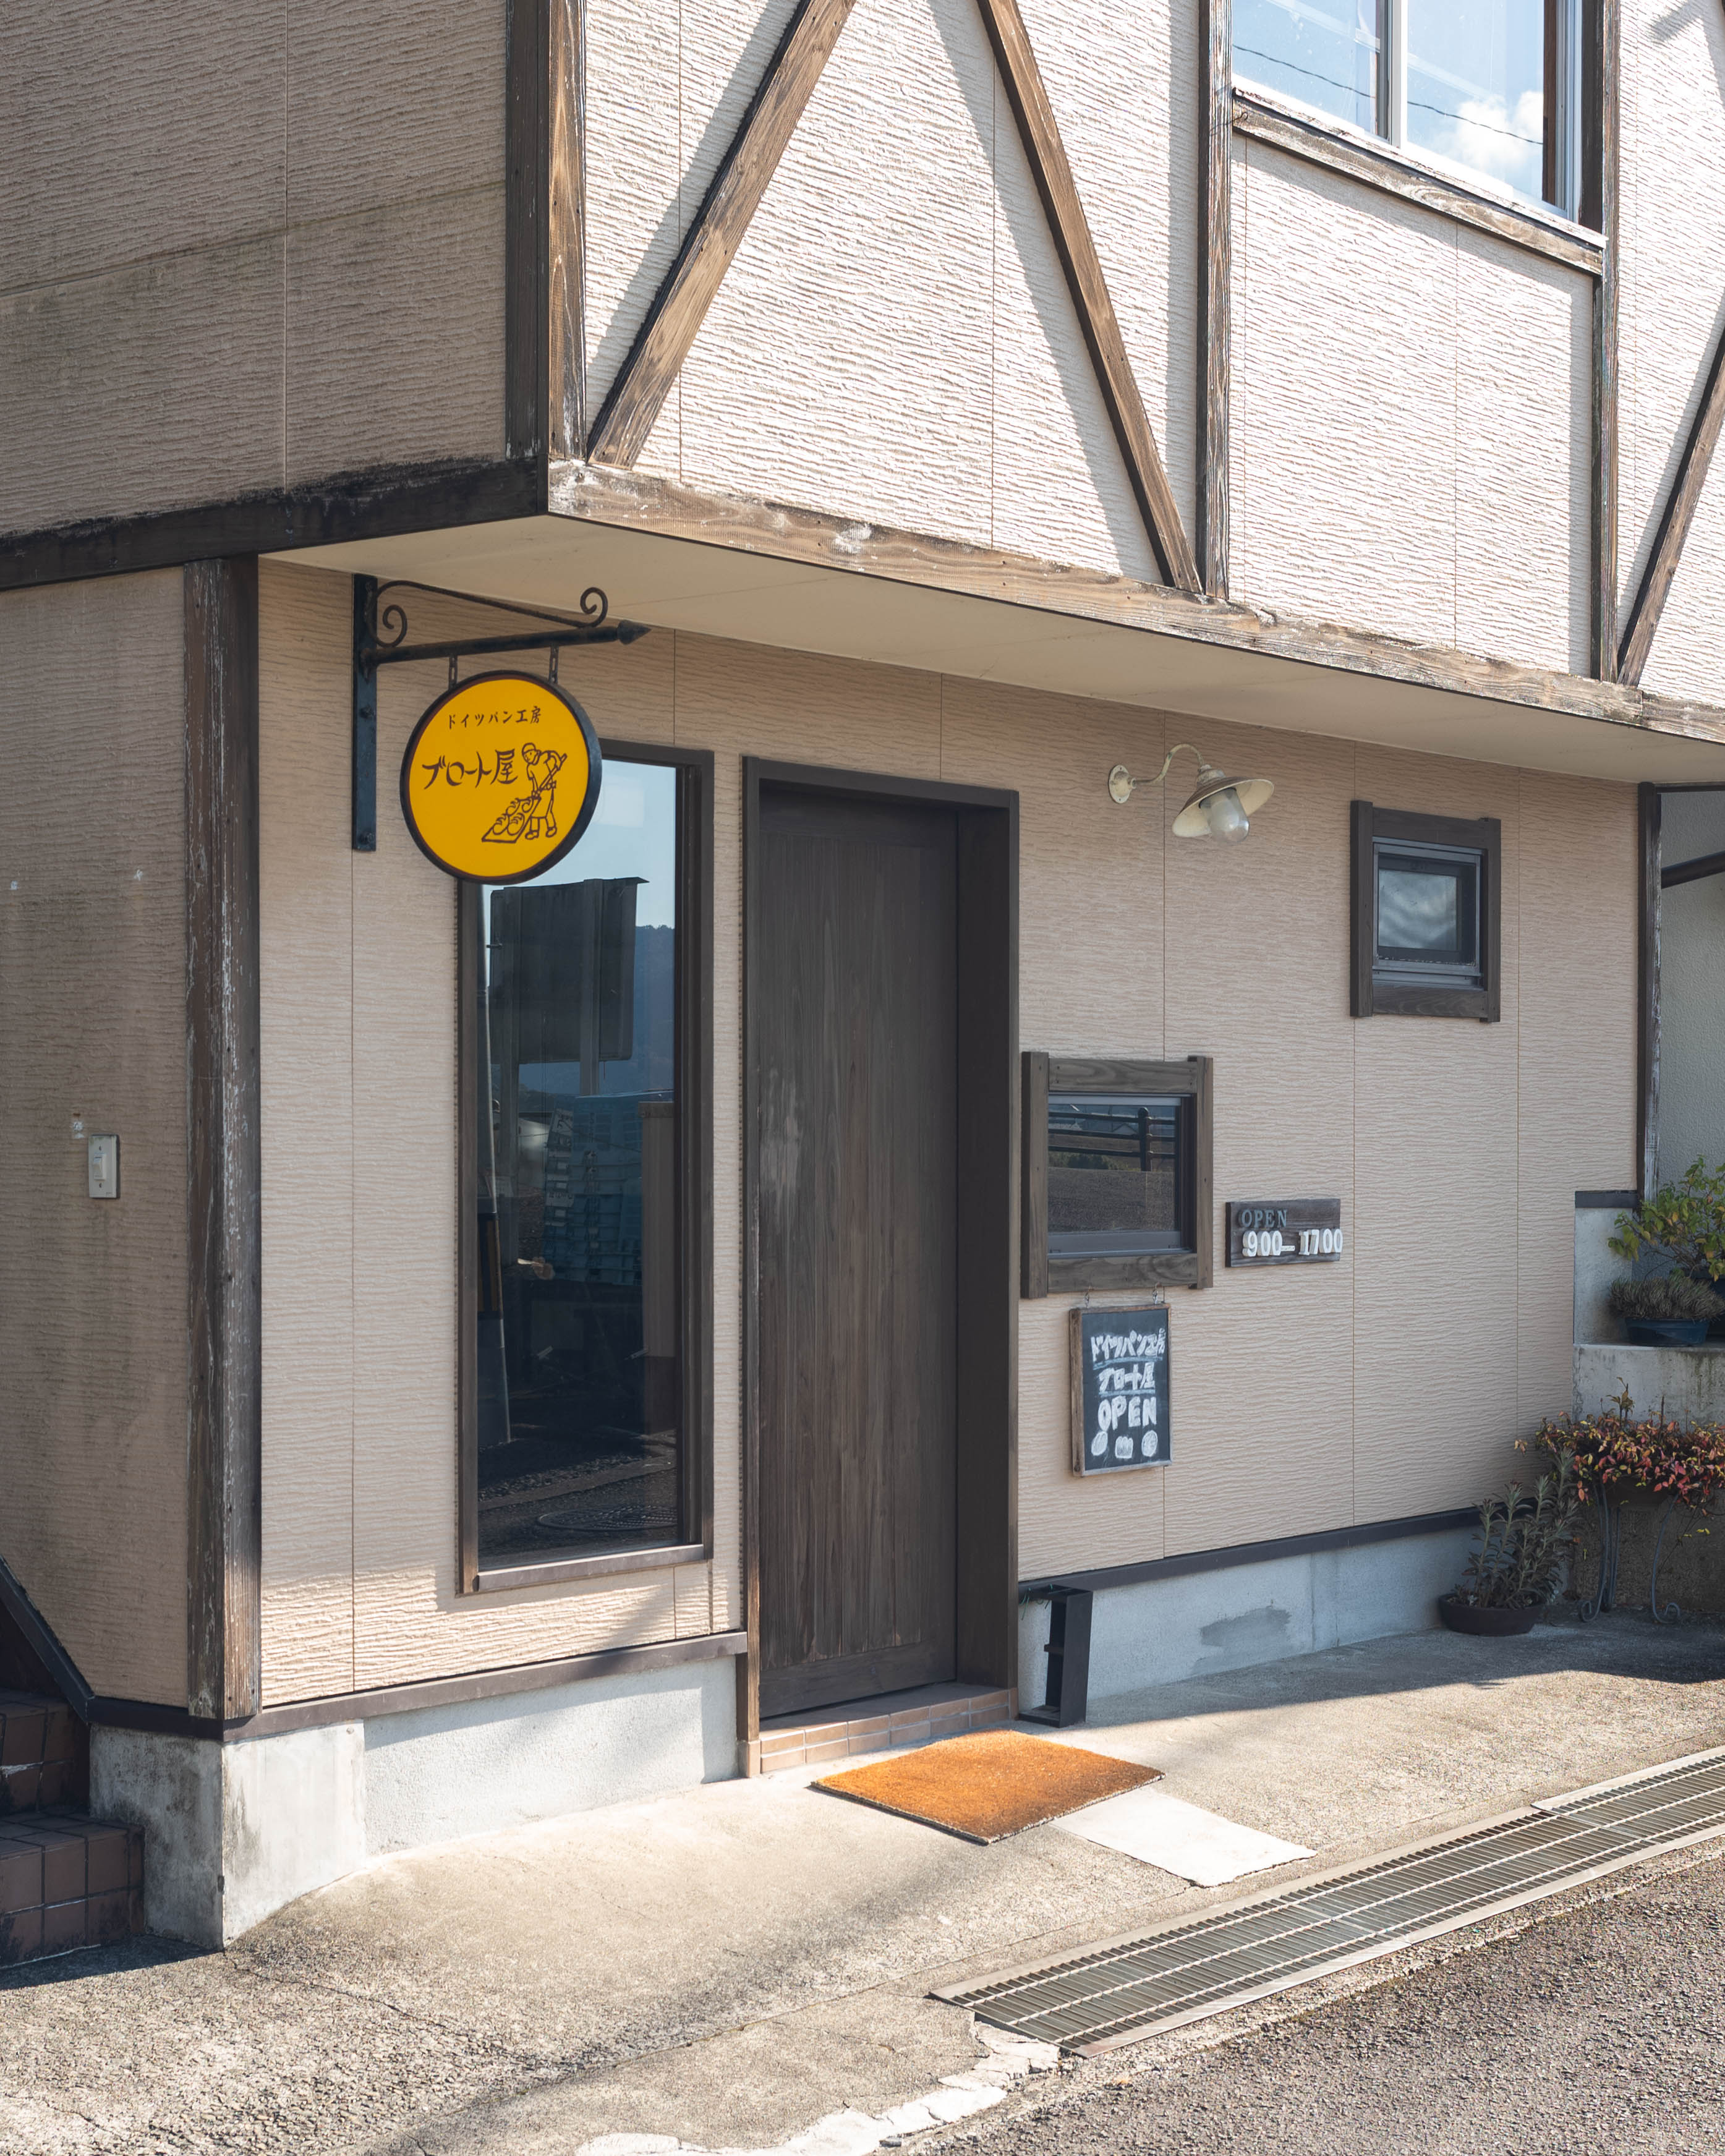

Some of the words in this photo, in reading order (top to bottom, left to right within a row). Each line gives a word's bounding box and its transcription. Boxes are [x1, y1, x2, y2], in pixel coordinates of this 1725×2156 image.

[448, 705, 542, 730] ドイツパン工房
[422, 748, 518, 790] ブロート屋
[1241, 1208, 1288, 1229] OPEN
[1097, 1395, 1157, 1432] OPEN
